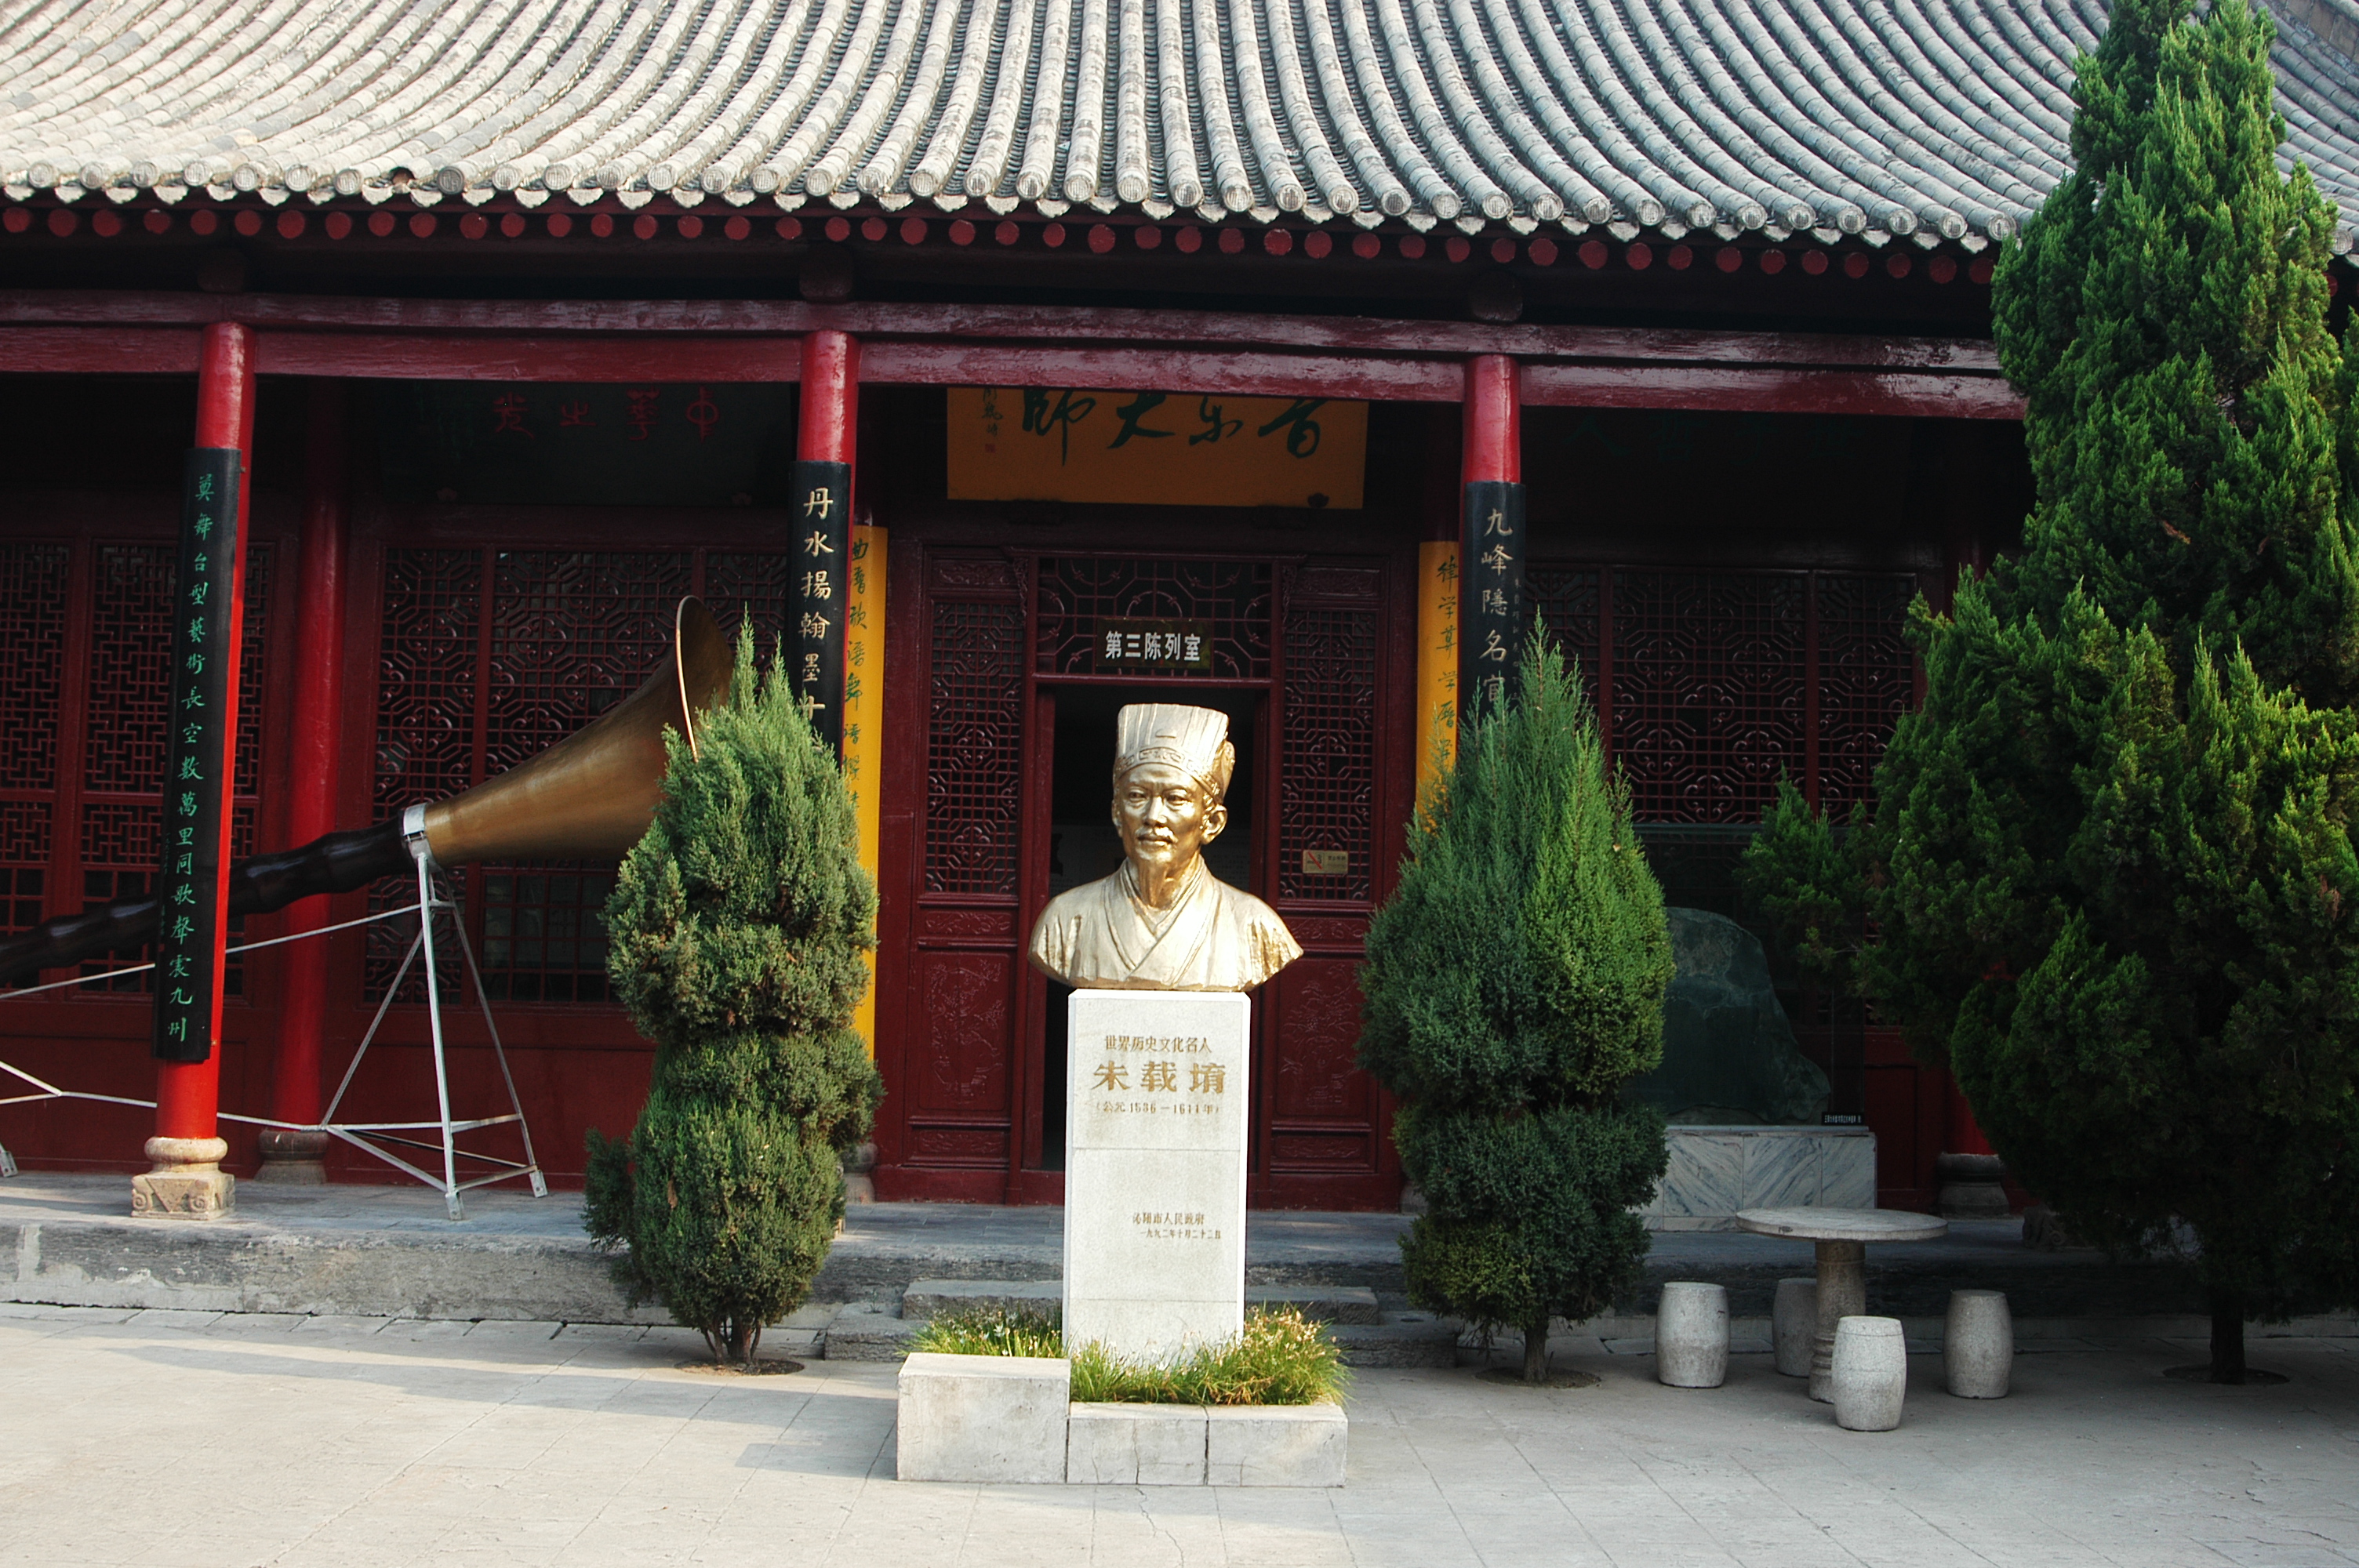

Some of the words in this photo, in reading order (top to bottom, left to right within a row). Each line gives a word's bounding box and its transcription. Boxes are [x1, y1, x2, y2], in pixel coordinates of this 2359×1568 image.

[1105, 630, 1201, 662] 第三陈列室
[1104, 1035, 1212, 1054] 世界历史文化名人
[1091, 1060, 1226, 1094] 朱载堉
